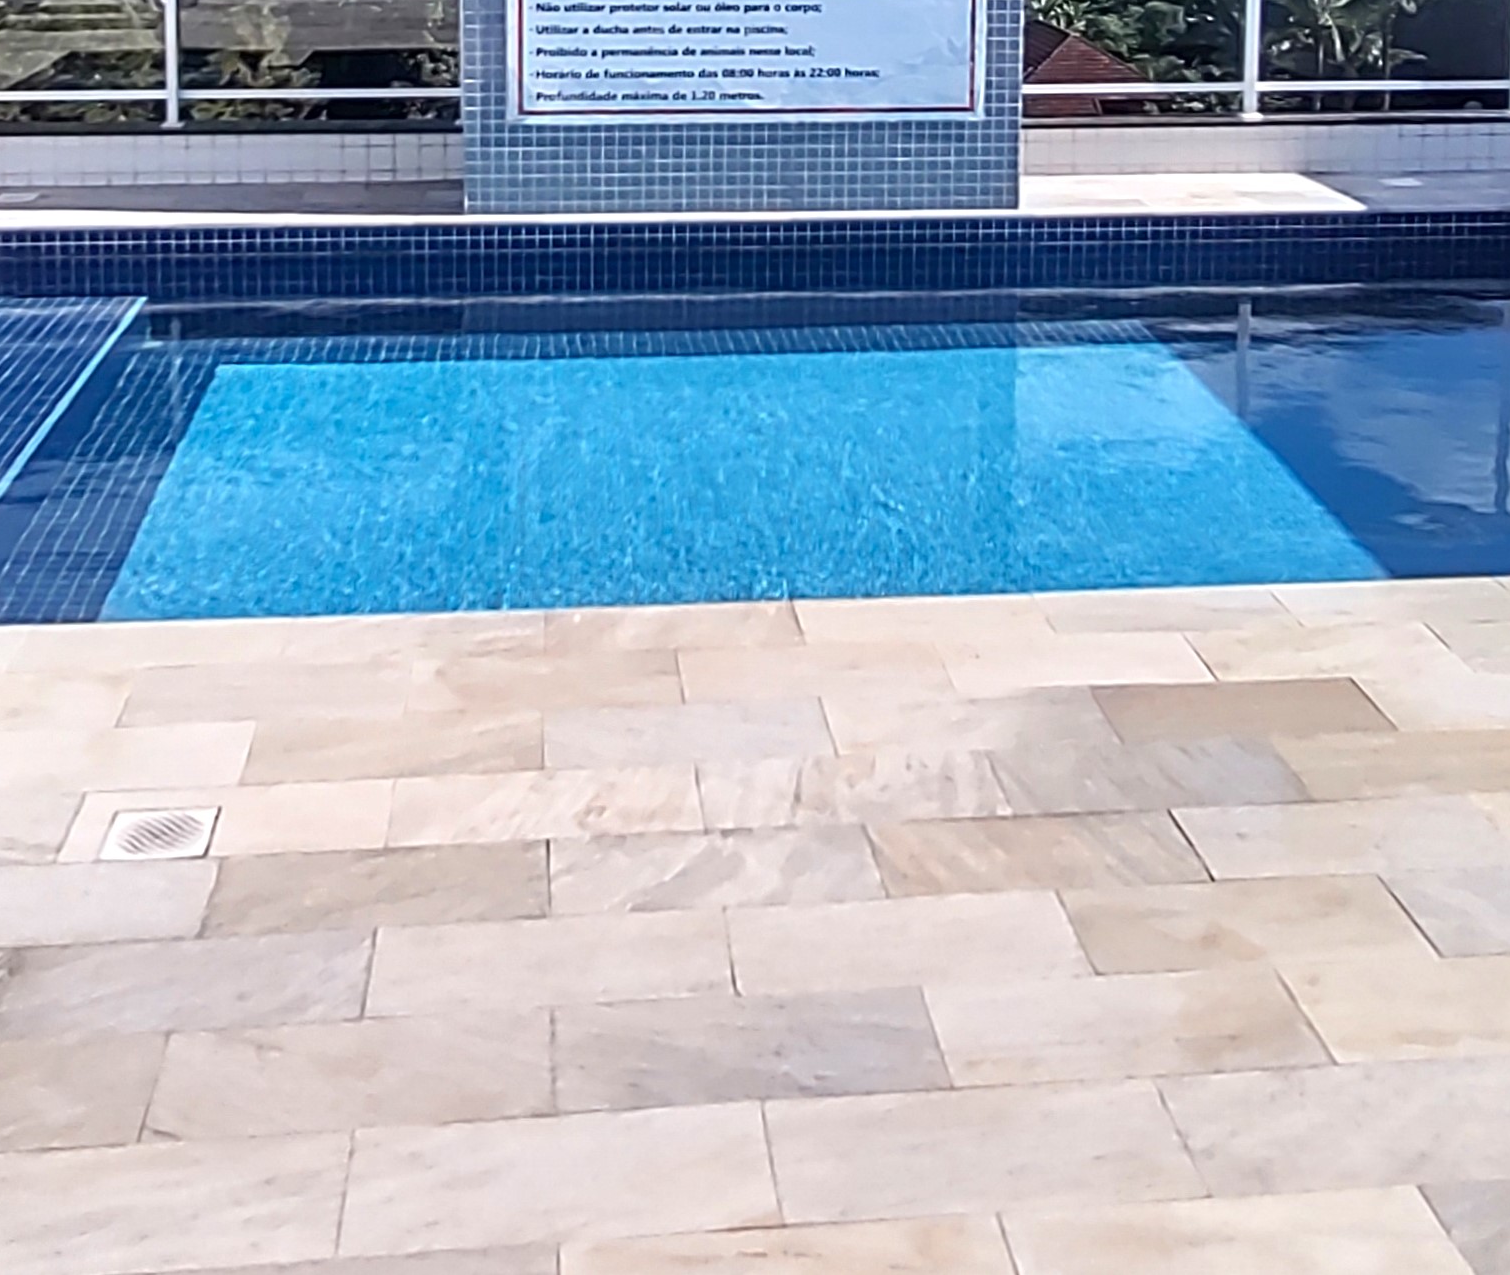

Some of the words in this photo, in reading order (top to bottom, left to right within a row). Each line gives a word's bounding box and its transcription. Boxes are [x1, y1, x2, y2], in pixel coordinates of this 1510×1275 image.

[536, 3, 561, 12] Não
[564, 3, 605, 12] utilizar
[609, 3, 659, 14] protetor
[663, 2, 692, 12] solar
[714, 2, 740, 12] óleo
[744, 5, 770, 14] para
[536, 25, 578, 34] Utilizar
[593, 25, 629, 34] ducha
[632, 26, 665, 34] antes
[668, 25, 683, 34] de
[686, 26, 722, 34] entrar
[536, 47, 588, 56] Proibido
[682, 47, 696, 56] de
[700, 47, 745, 56] animais
[536, 69, 582, 79] Horário
[586, 69, 599, 78] de
[604, 69, 695, 78] funcionamento
[698, 69, 718, 78] das
[758, 69, 790, 77] horas
[810, 68, 841, 77] 22:00
[536, 92, 617, 101] Profundidade
[621, 92, 668, 101] máxima
[672, 92, 687, 101] de
